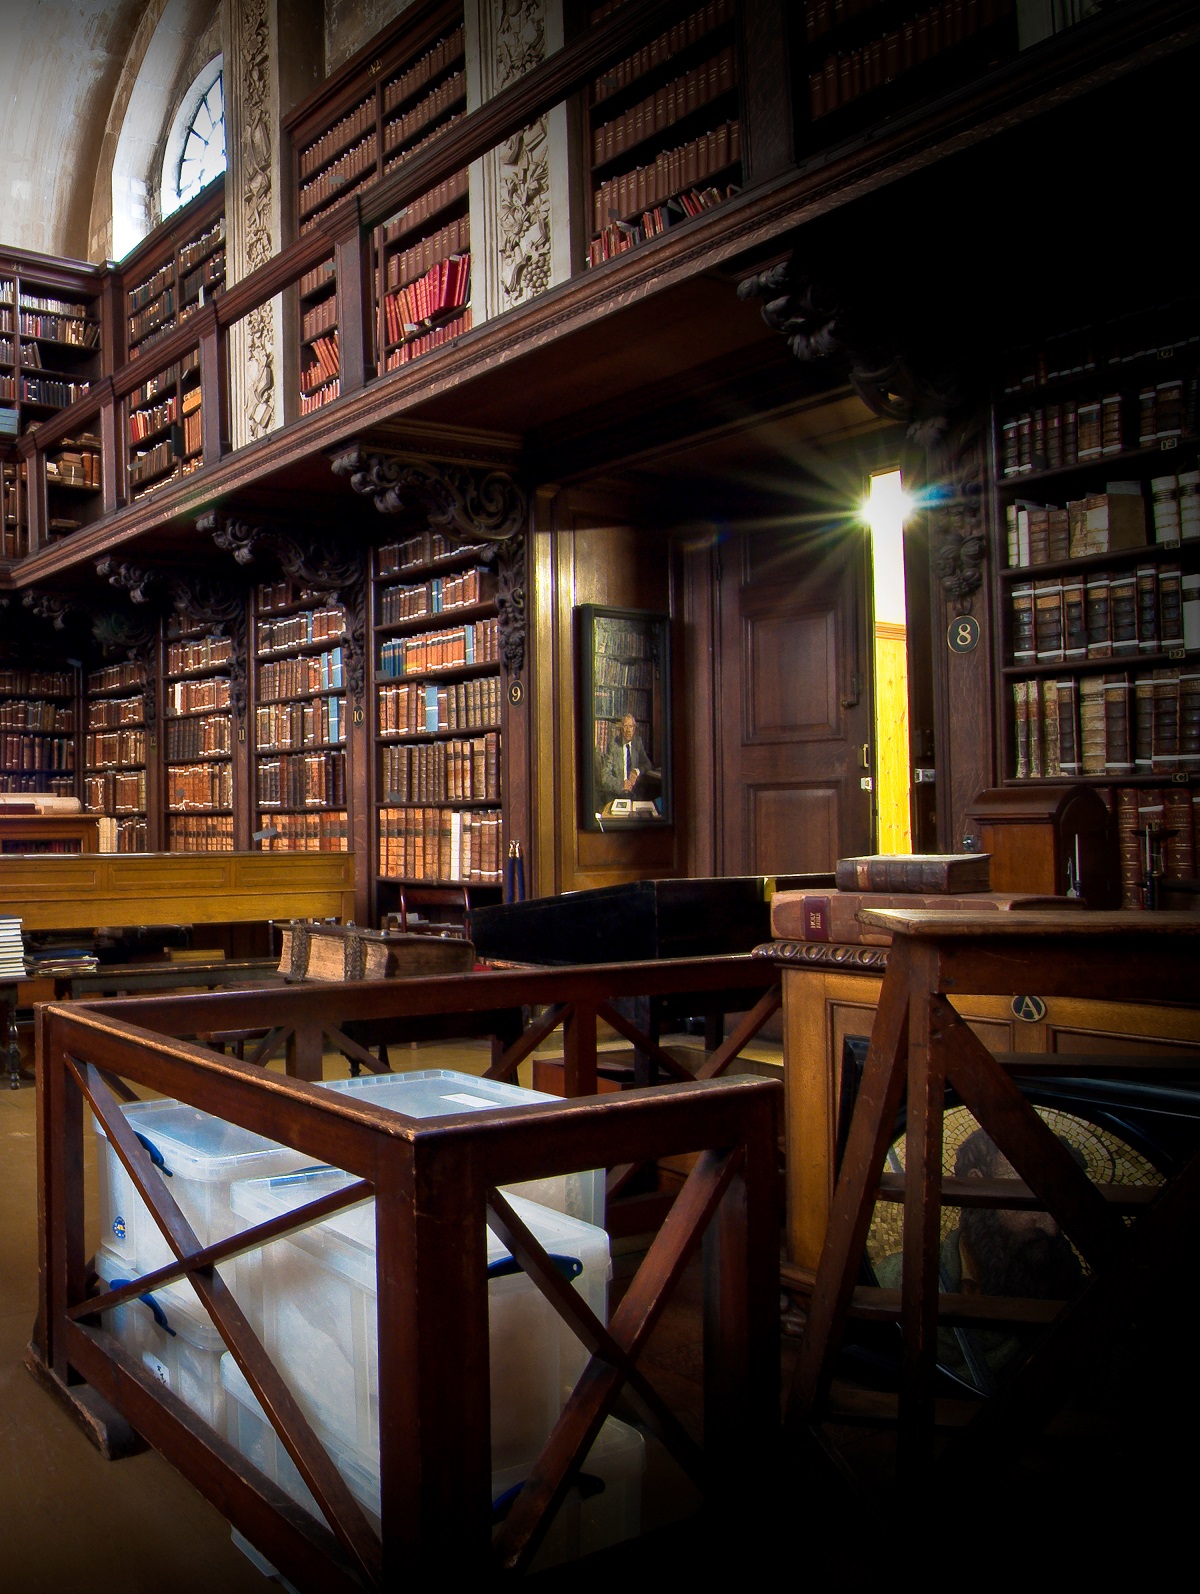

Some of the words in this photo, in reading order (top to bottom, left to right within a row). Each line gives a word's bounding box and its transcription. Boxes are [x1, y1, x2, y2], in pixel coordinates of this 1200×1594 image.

[956, 623, 971, 645] 8
[512, 686, 521, 702] 9
[353, 713, 363, 724] 10
[238, 730, 245, 740] 11
[1019, 995, 1041, 1020] A
